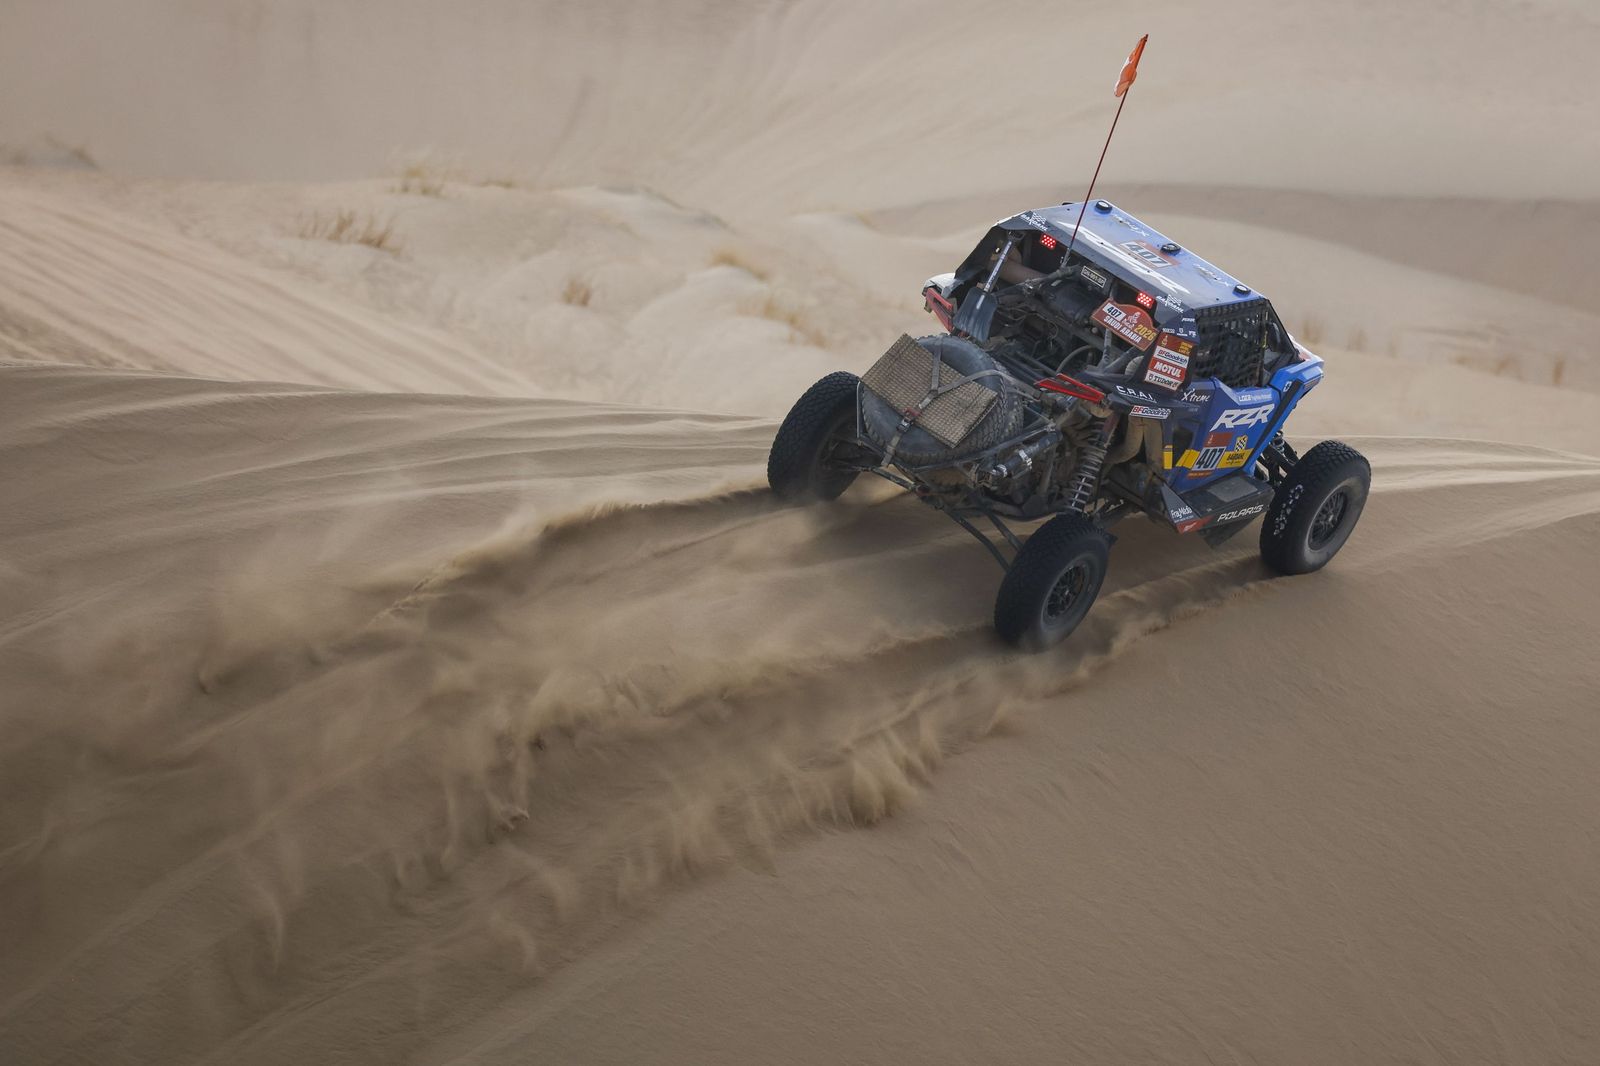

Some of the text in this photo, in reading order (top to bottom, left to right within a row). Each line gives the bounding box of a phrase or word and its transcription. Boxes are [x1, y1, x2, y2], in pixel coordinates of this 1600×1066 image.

[1125, 243, 1169, 264] 407
[1106, 306, 1122, 318] 407
[1103, 316, 1142, 343] SAUDI ARABIA
[1134, 324, 1157, 341] 2026
[1158, 349, 1188, 364] BFGoodrich
[1153, 361, 1182, 377] MOTUL
[1154, 375, 1173, 386] TUDOR
[1133, 405, 1171, 416] BFGoodrich
[1209, 403, 1275, 432] RZR
[1195, 448, 1225, 469] 407
[1217, 504, 1264, 522] POLARIS
